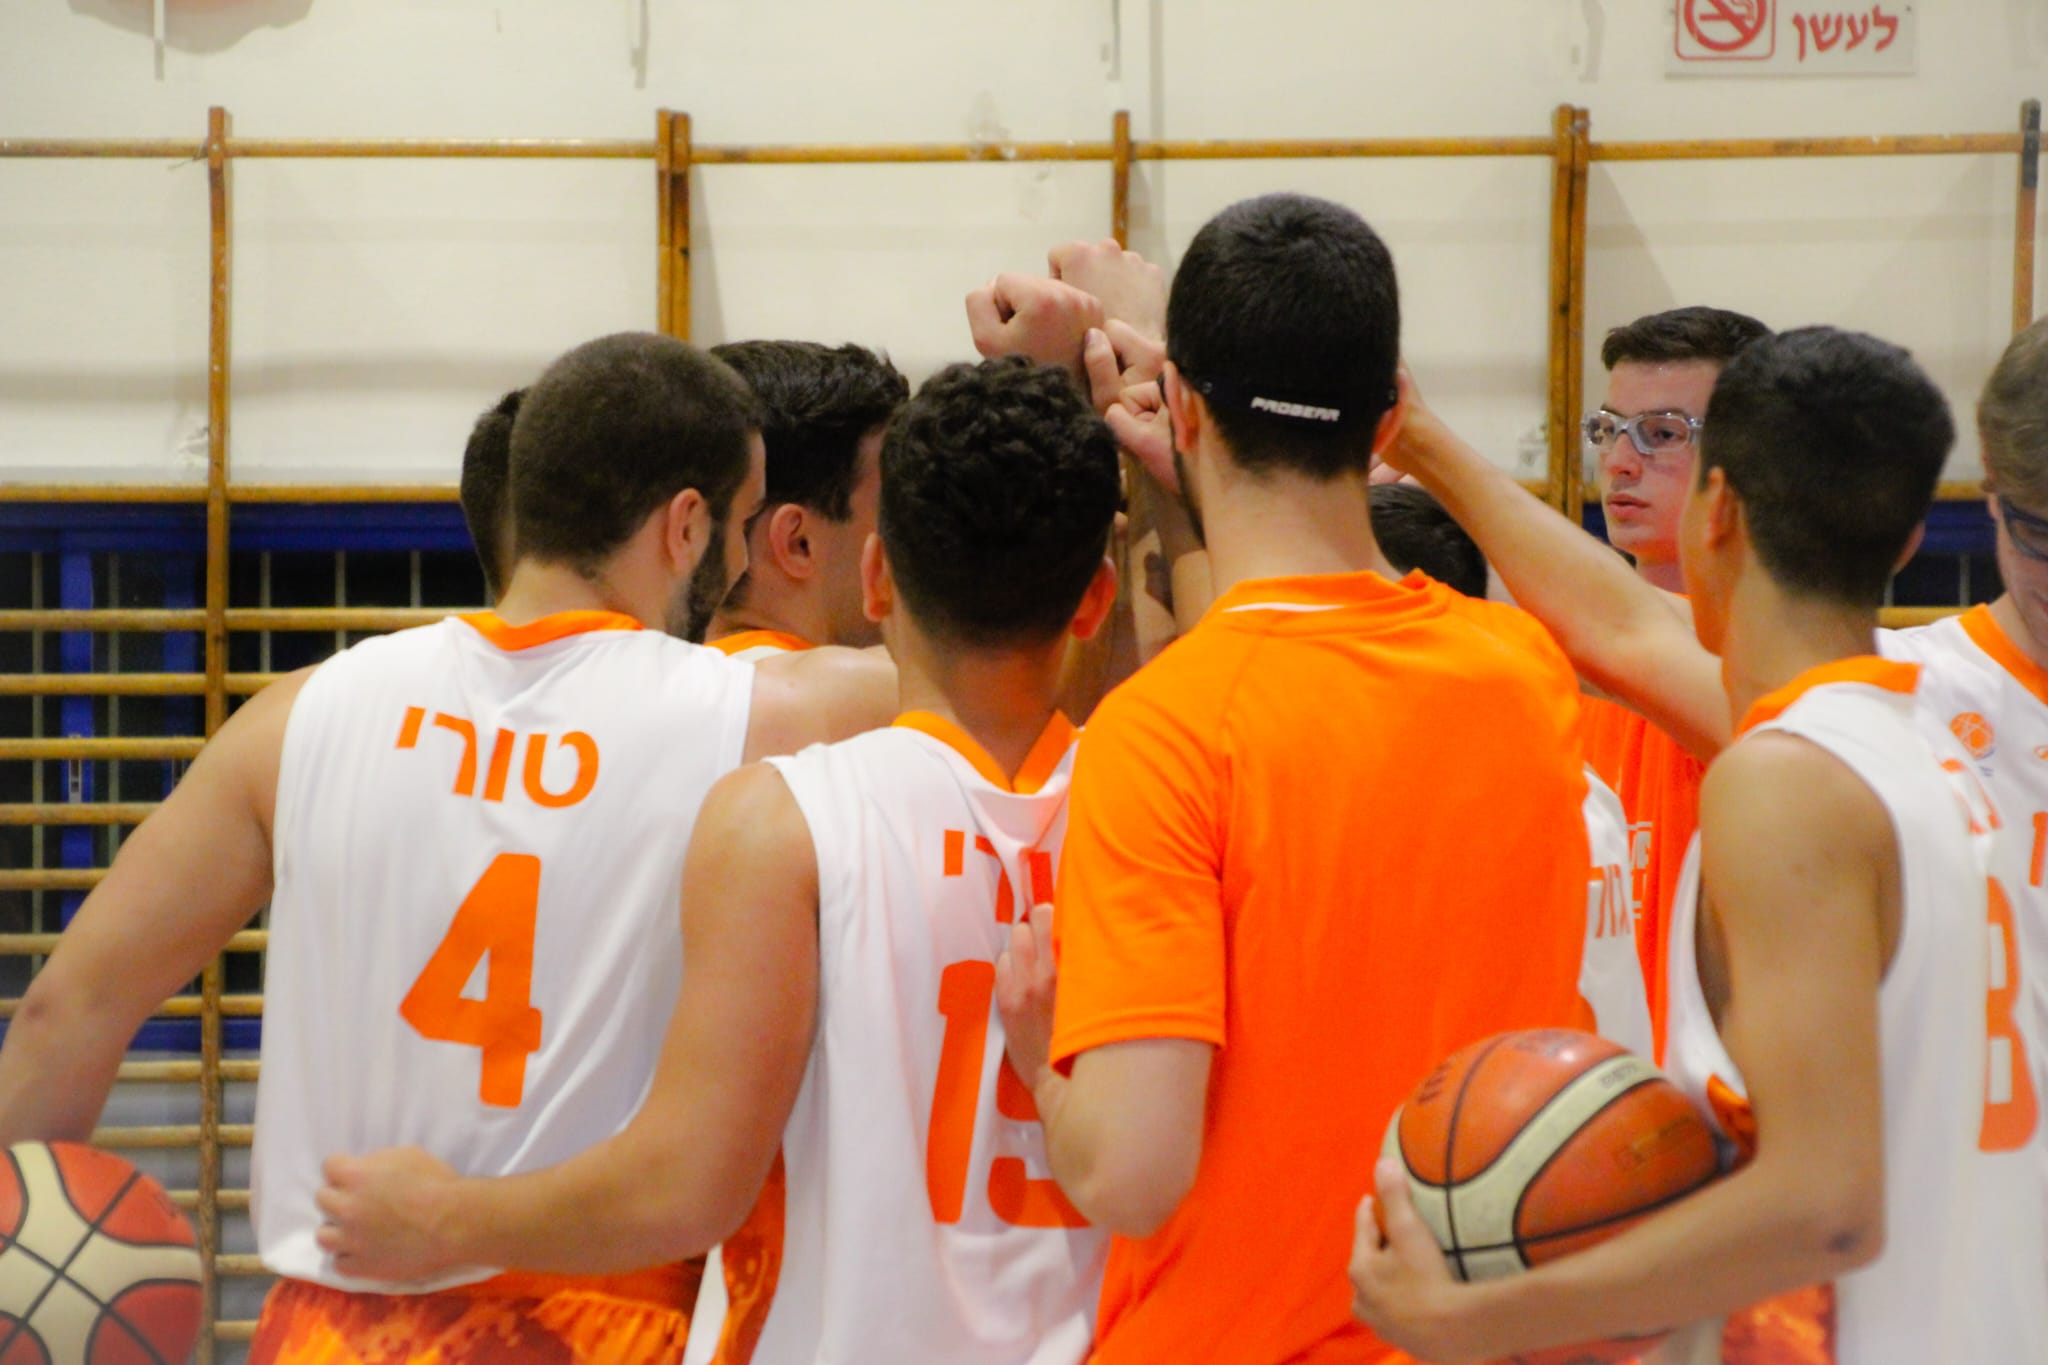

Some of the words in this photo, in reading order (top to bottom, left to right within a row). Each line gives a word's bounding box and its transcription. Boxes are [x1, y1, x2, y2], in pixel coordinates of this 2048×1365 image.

[1791, 4, 1899, 63] לעשן
[394, 705, 600, 809] טורי
[397, 852, 544, 1109] 4
